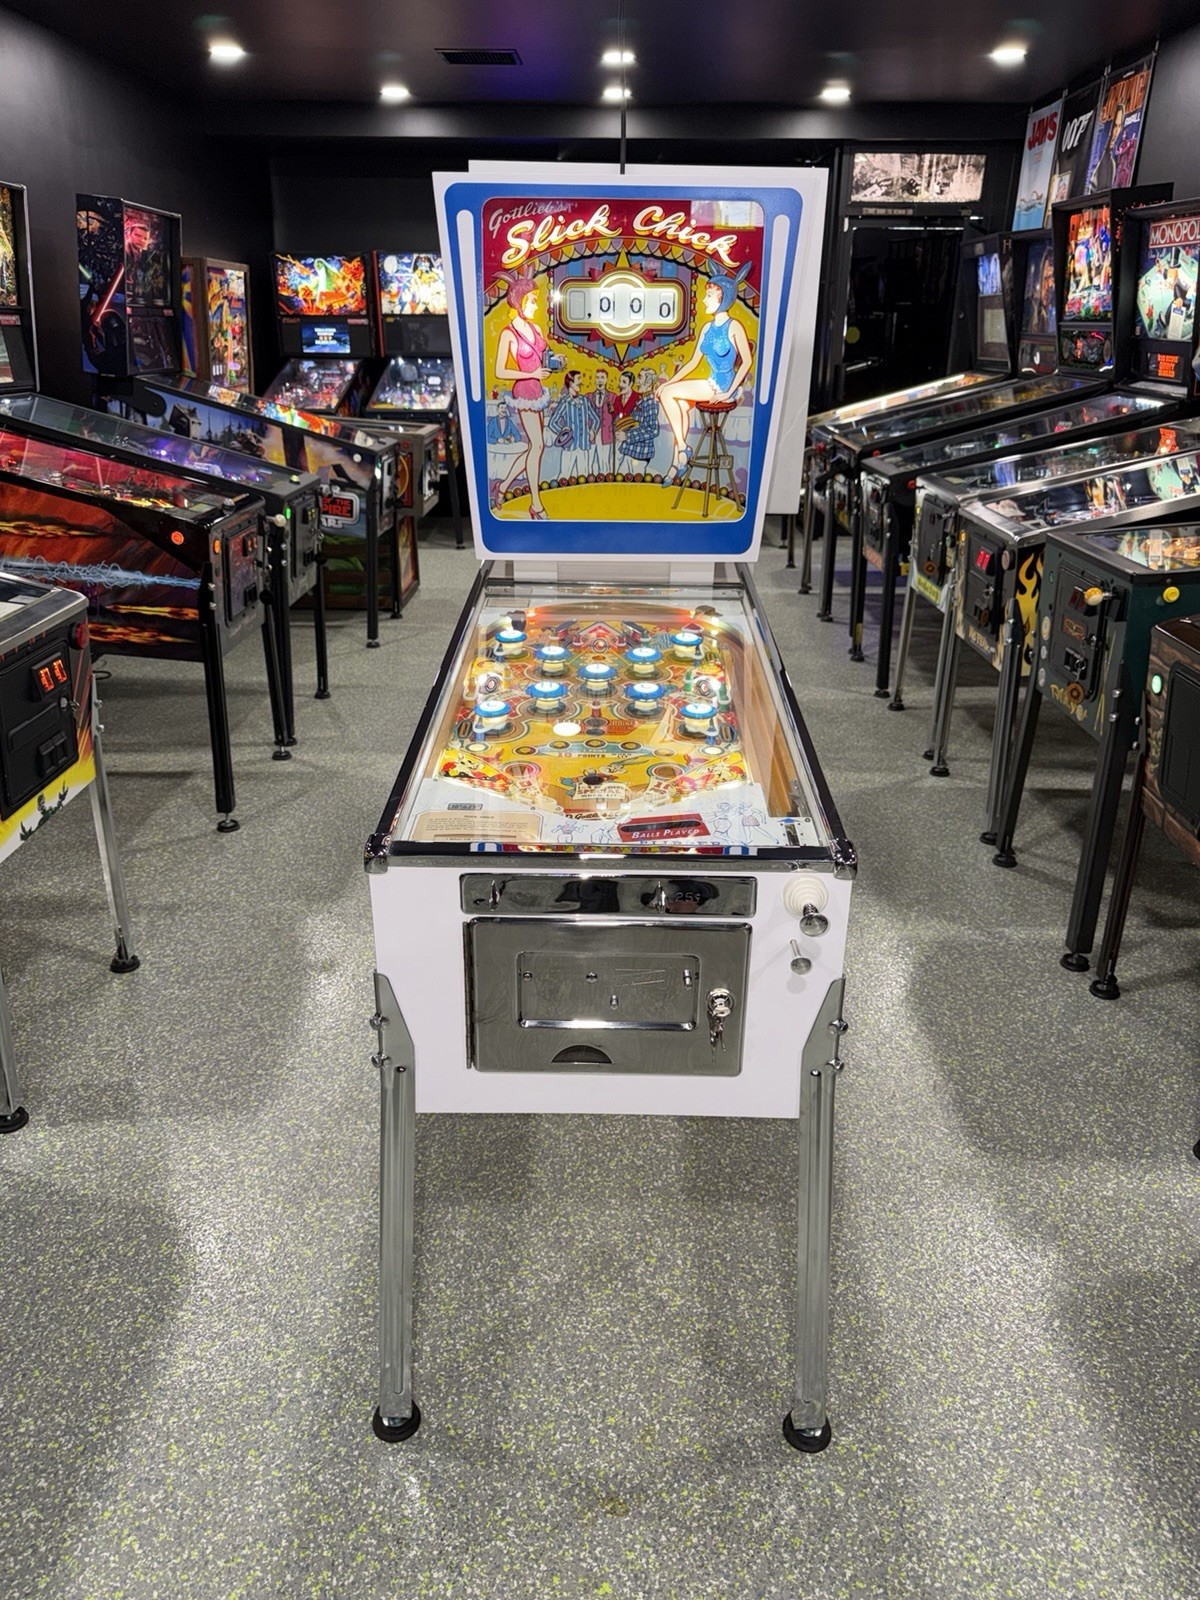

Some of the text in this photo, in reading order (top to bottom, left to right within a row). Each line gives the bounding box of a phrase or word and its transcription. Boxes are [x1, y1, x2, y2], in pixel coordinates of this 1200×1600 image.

[1027, 111, 1058, 151] JAWS
[1062, 109, 1094, 153] 007
[501, 204, 741, 270] Slick Chick
[321, 517, 343, 528] ARS
[322, 504, 351, 517] PIRE
[631, 828, 700, 839] BALLS PLAYED
